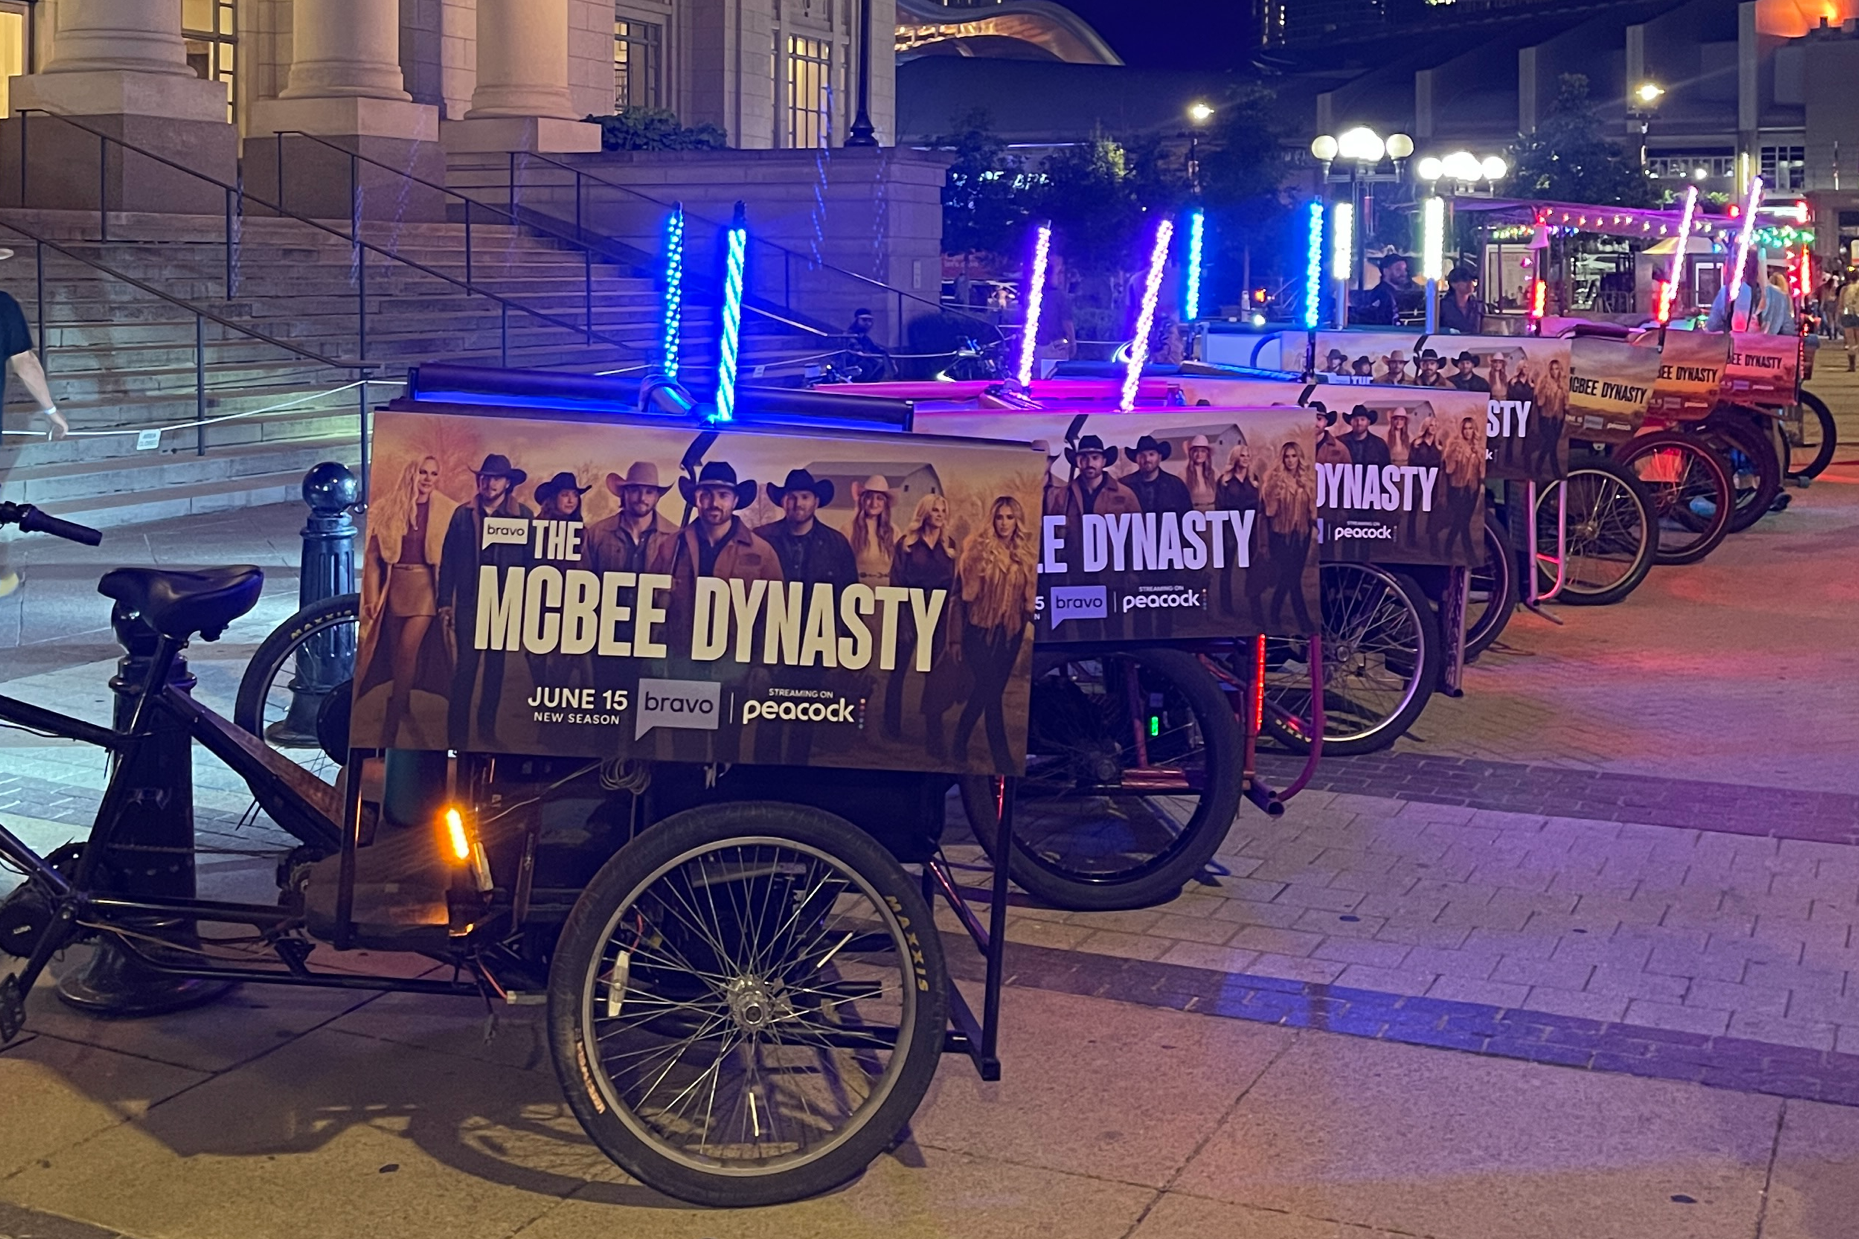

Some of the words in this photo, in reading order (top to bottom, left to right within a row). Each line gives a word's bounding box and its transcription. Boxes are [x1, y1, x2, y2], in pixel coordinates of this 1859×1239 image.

[1676, 366, 1718, 383] DYNASTY
[1744, 355, 1782, 370] DYNASTY
[1601, 382, 1647, 405] DYNASTY
[486, 524, 526, 537] bravo
[532, 519, 584, 561] THE
[1037, 514, 1068, 574] E
[1082, 510, 1256, 573] DYNASTY
[1334, 525, 1392, 541] peacock
[1055, 594, 1103, 609] bravo
[1123, 589, 1200, 613] peacock
[290, 608, 353, 641] MAXXIS
[474, 564, 673, 658] MCBEE
[691, 576, 948, 672] DYNASTY
[527, 686, 595, 710] JUNE
[602, 689, 629, 711] 15
[643, 691, 714, 715] bravo
[768, 686, 815, 699] STREAMING
[819, 690, 834, 699] ON
[533, 710, 562, 723] NEW
[567, 713, 621, 725] SEASON
[742, 697, 856, 725] peacock
[885, 895, 930, 993] MAXXIS
